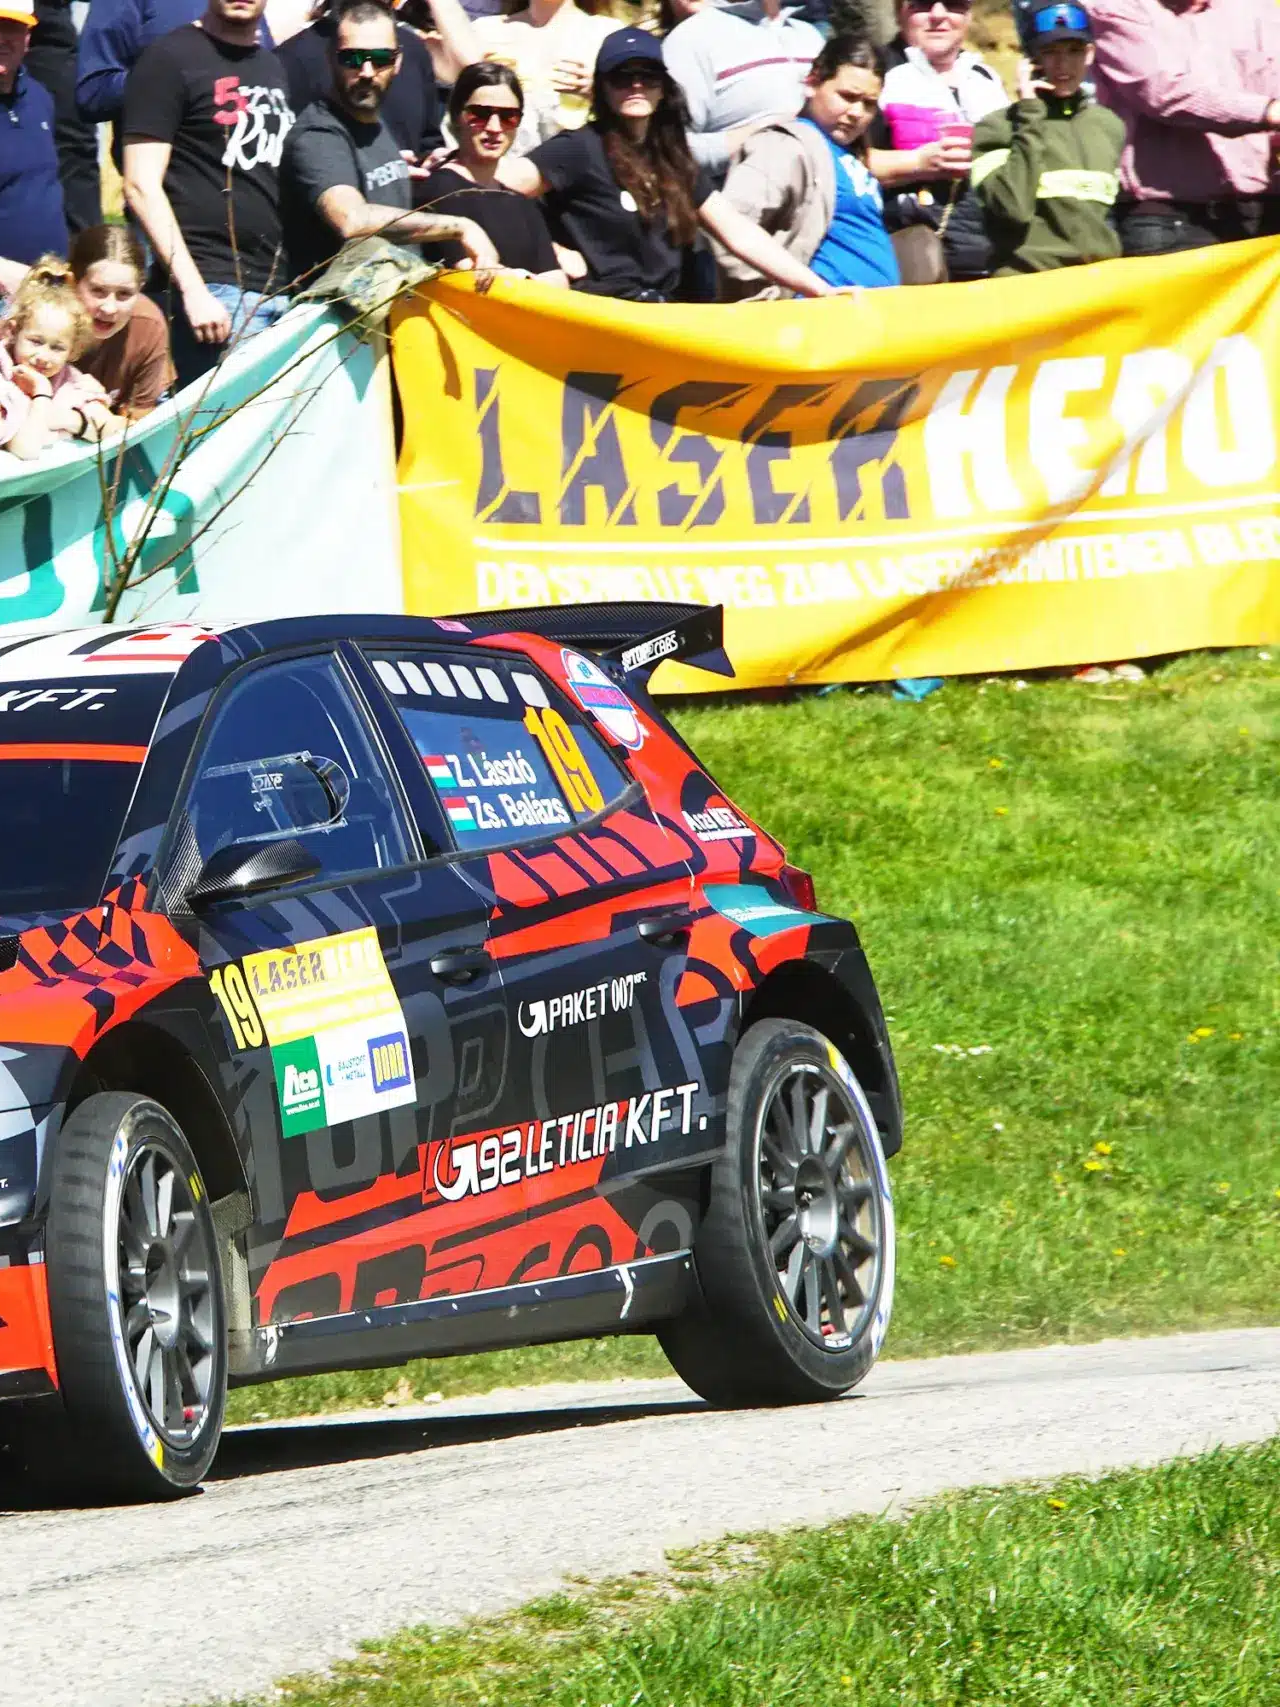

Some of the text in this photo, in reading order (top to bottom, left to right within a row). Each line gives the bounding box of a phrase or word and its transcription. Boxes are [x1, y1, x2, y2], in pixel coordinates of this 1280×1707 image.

[476, 561, 551, 607] DER
[693, 564, 778, 608] WEG
[447, 750, 537, 788] Z. László
[523, 706, 607, 814] 19
[466, 789, 571, 830] Zs. Balázs
[208, 964, 264, 1050] 19
[548, 983, 609, 1032] PAKET
[610, 975, 635, 1012] 007
[525, 1100, 617, 1177] LETICIA
[624, 1082, 708, 1149] KFT.
